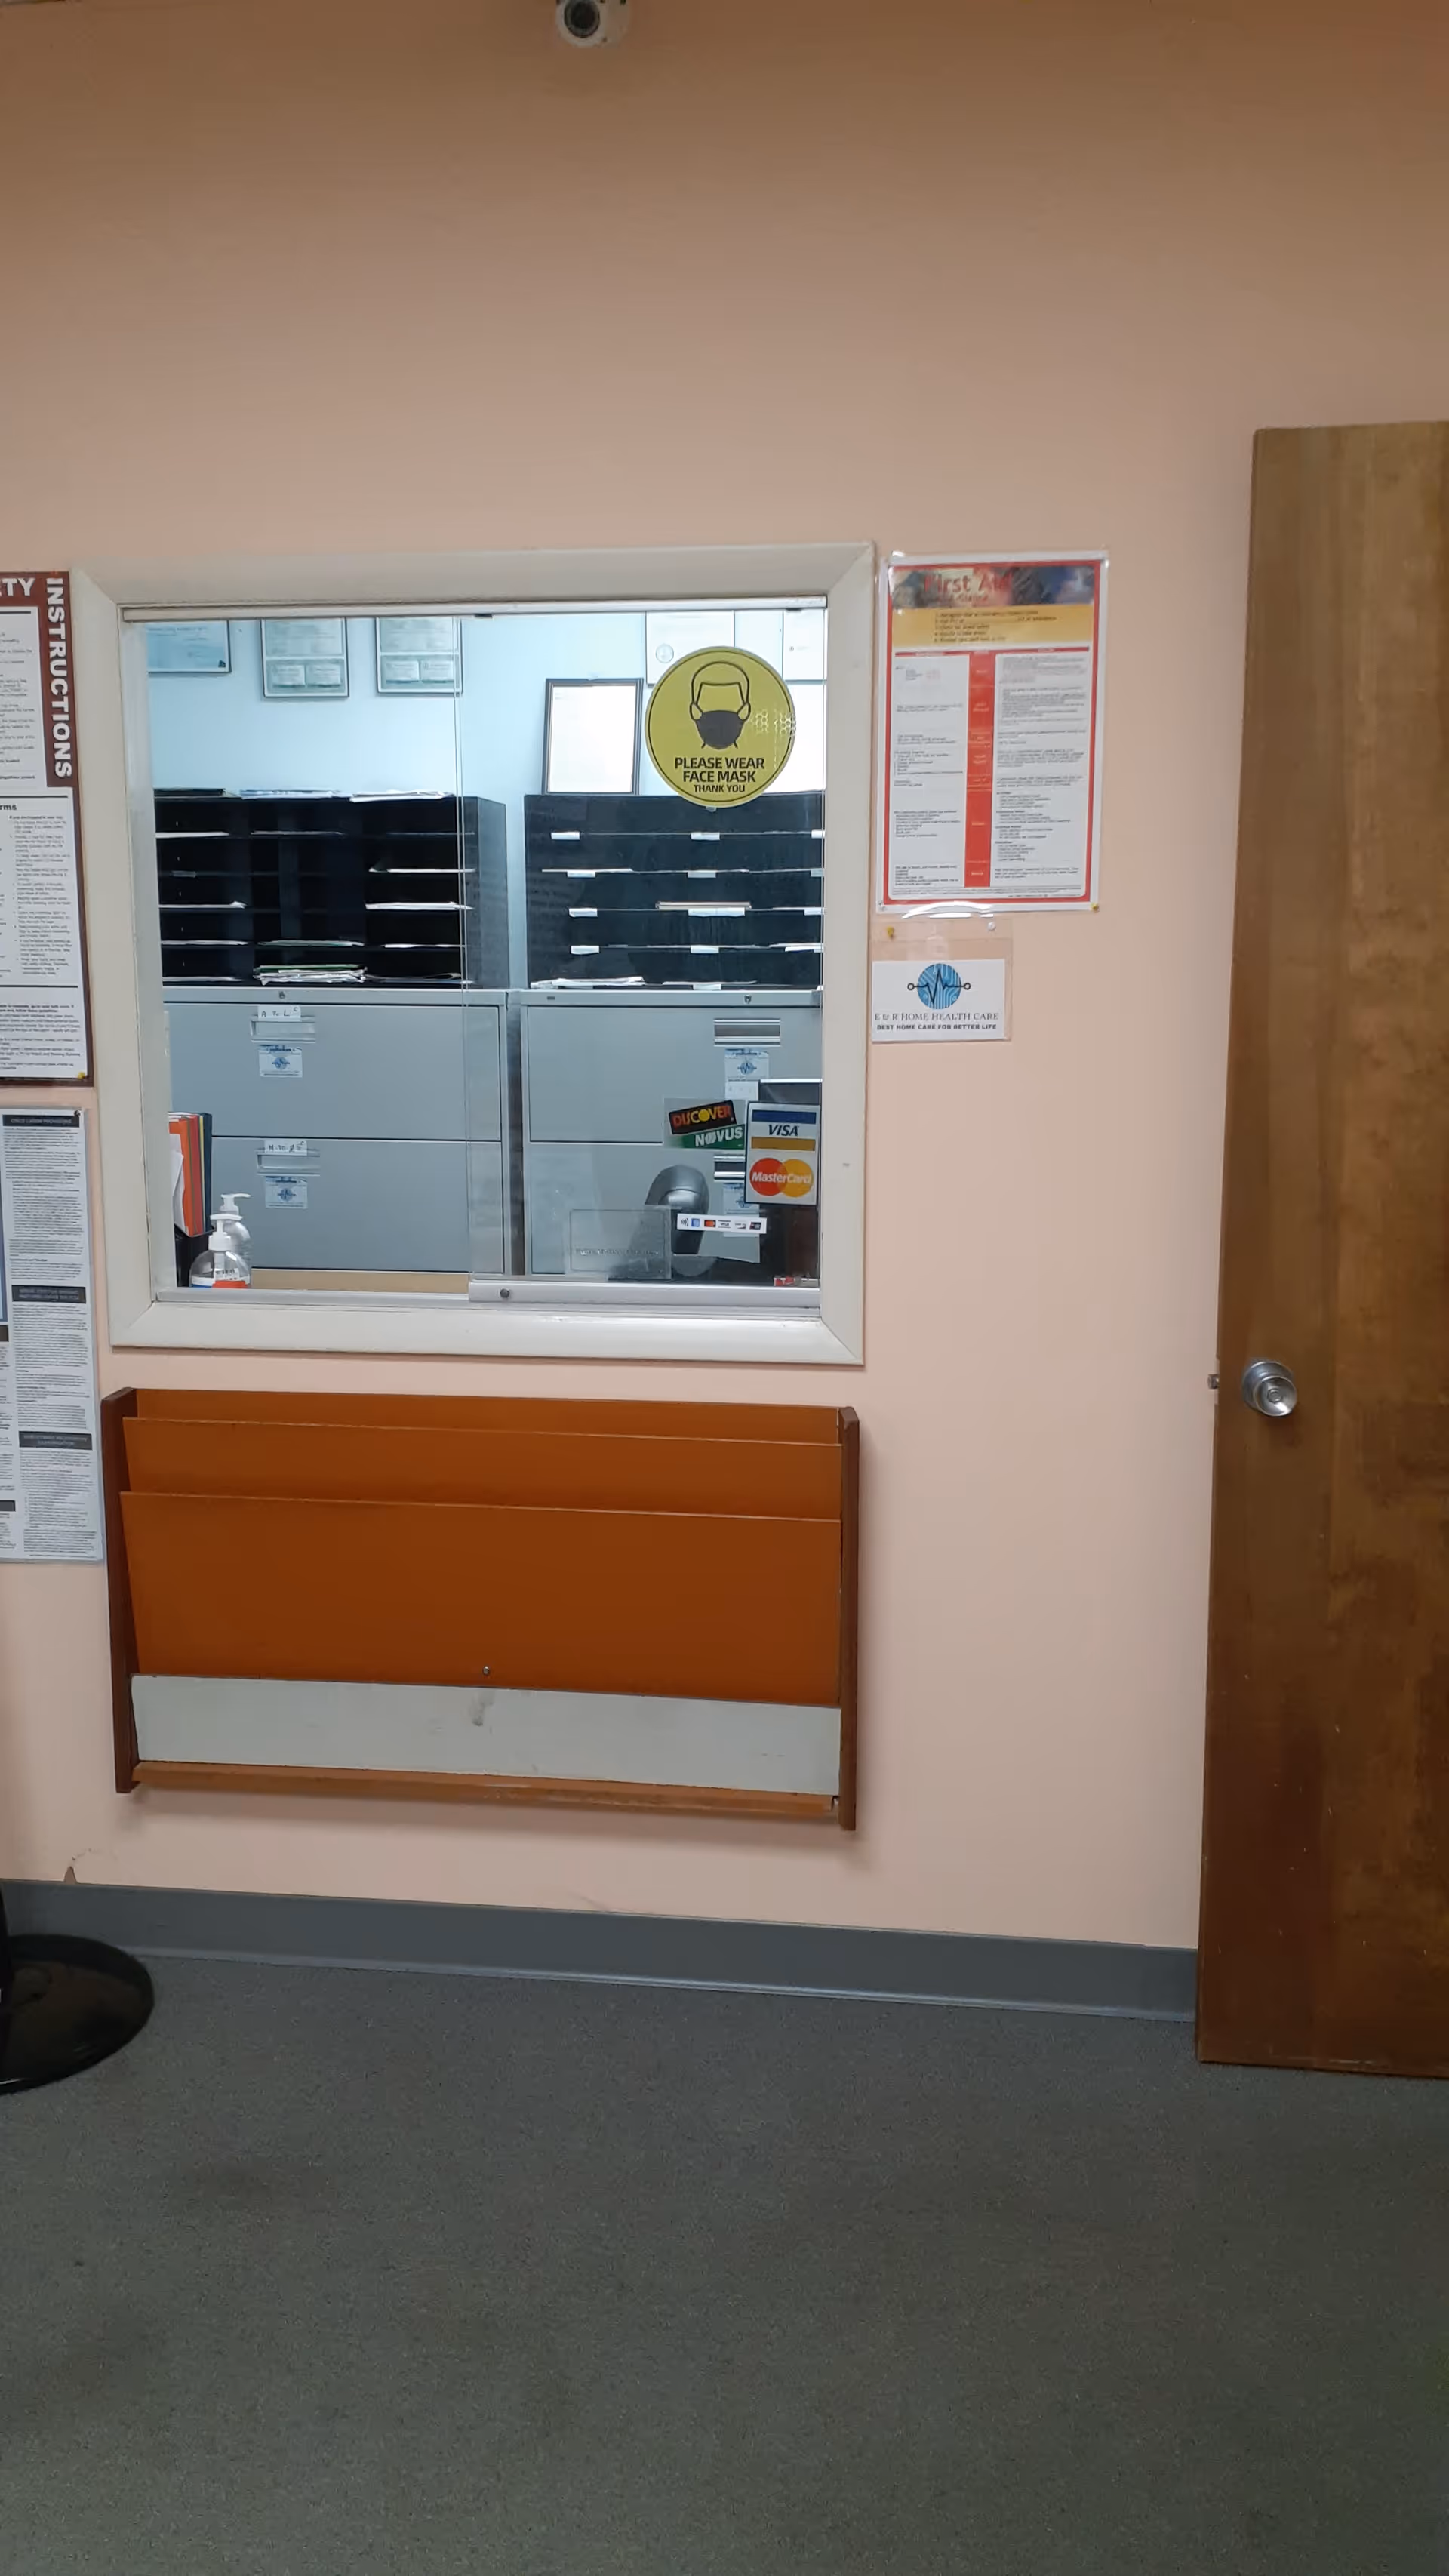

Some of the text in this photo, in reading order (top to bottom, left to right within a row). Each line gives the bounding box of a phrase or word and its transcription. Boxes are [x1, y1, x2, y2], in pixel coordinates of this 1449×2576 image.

[0, 578, 36, 596] TY
[46, 578, 72, 778] INSTRUCTIONS
[675, 757, 764, 769] PLEASE WEAR
[683, 771, 756, 783] FACE MASK
[694, 784, 745, 793] THANK YOU
[901, 1013, 928, 1021] HOME
[973, 1012, 999, 1020] CARE
[672, 1104, 731, 1128] DISCOVER
[695, 1127, 743, 1147] NOVUS
[768, 1125, 800, 1137] VISA
[751, 1171, 812, 1184] MasterCard
